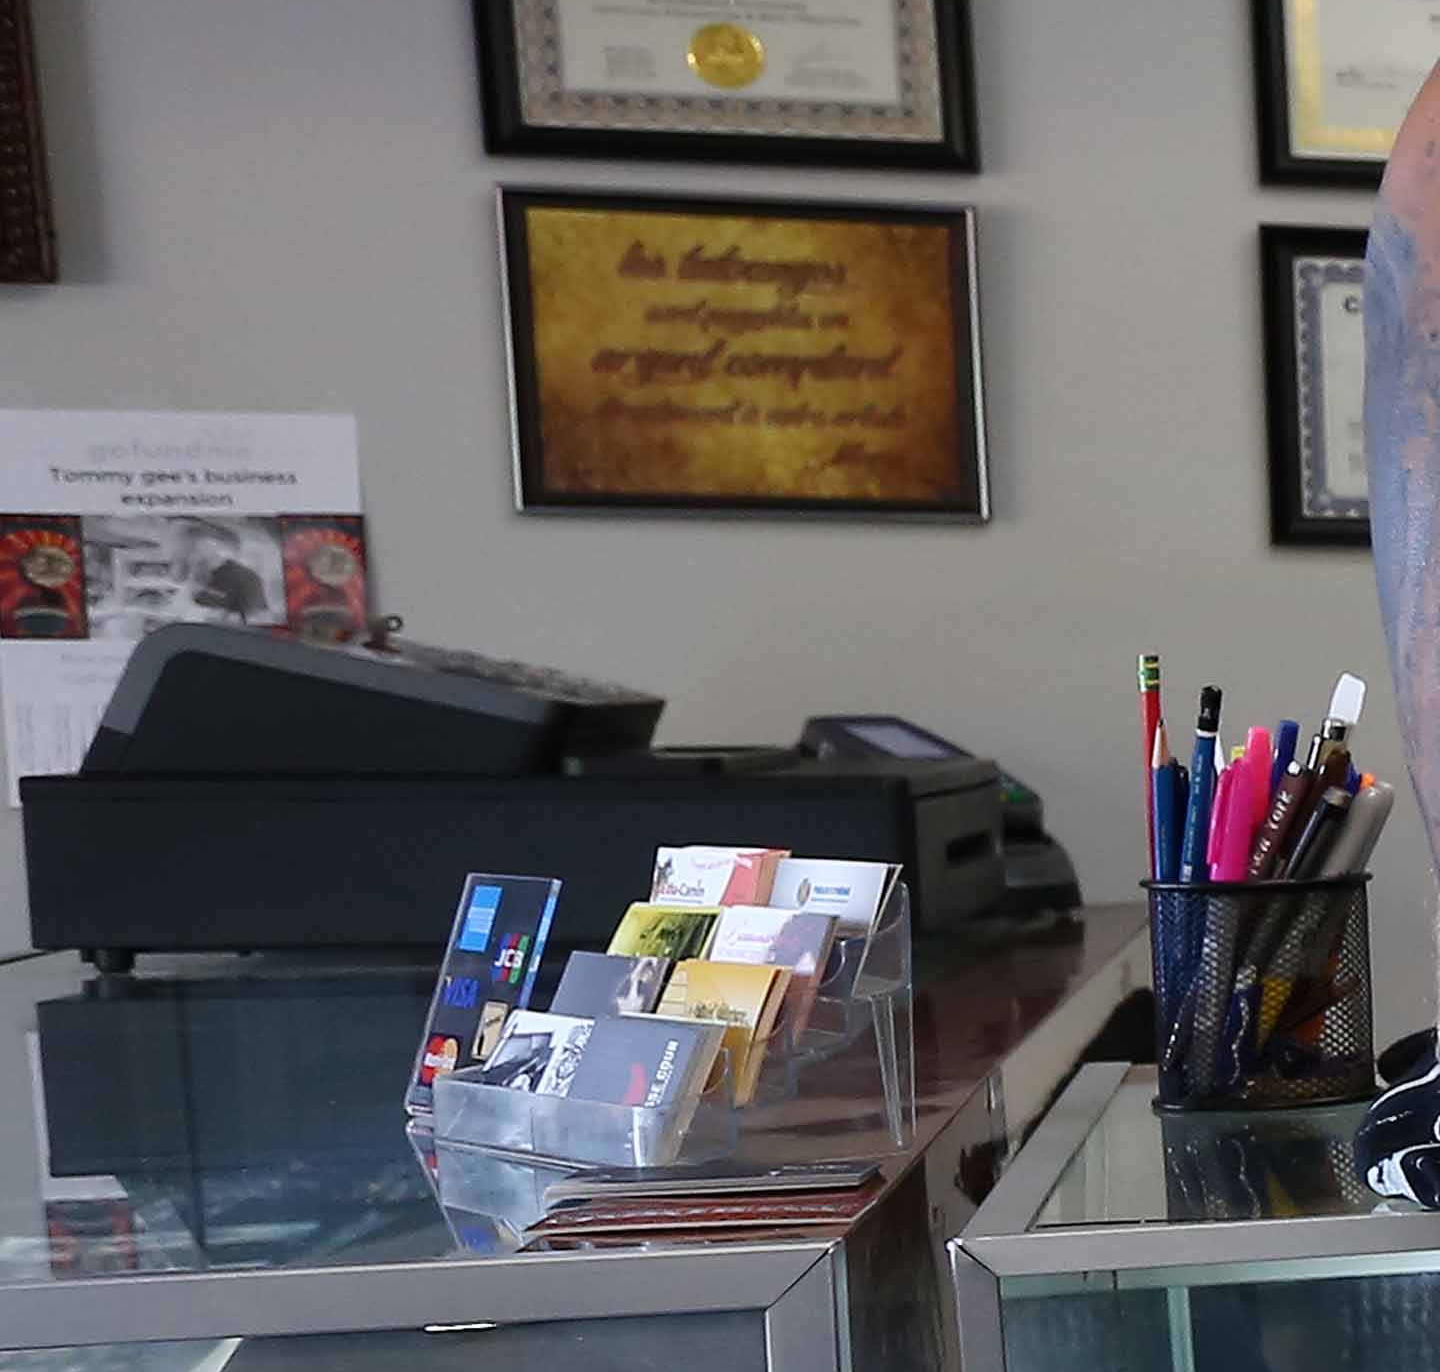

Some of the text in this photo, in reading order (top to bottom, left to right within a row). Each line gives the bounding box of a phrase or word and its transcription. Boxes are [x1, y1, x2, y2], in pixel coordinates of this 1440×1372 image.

[50, 466, 134, 489] Tommy
[204, 467, 299, 486] business
[120, 490, 235, 508] expansion
[494, 947, 524, 970] JCB
[442, 976, 480, 1009] VISA
